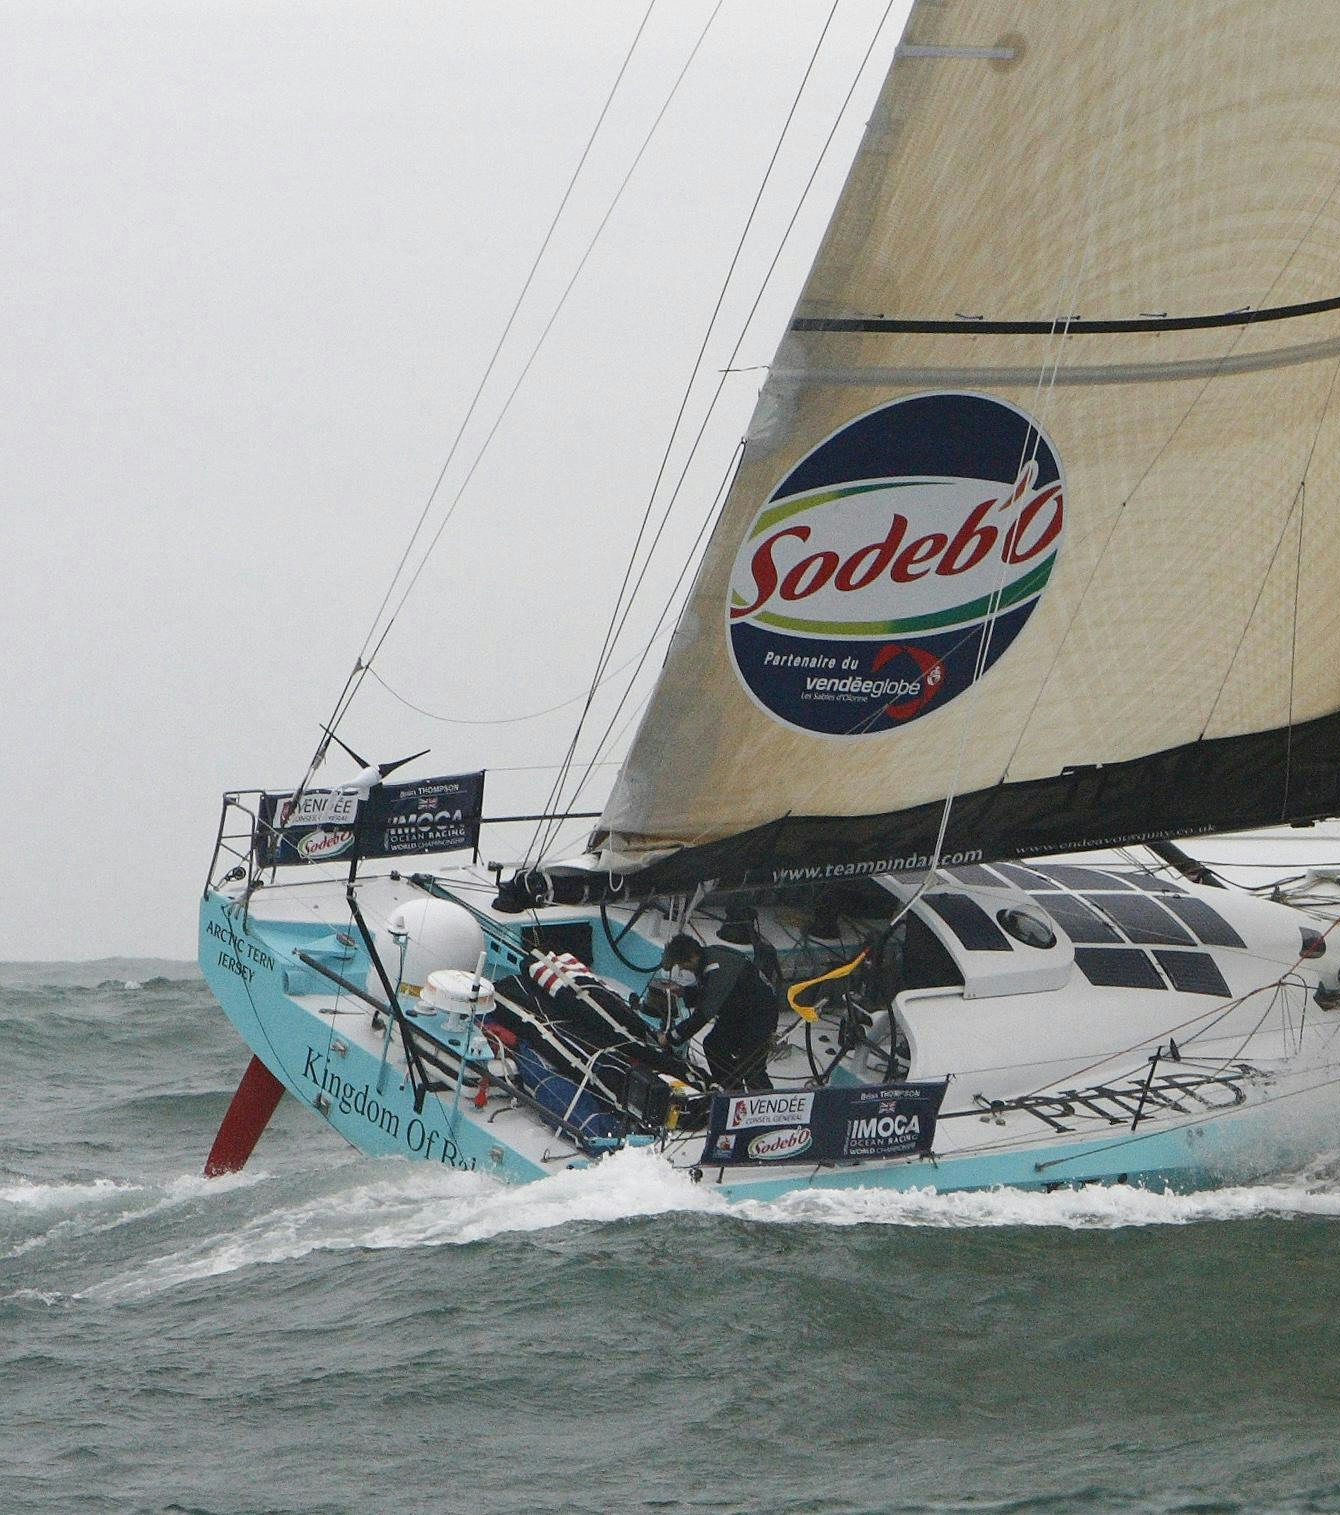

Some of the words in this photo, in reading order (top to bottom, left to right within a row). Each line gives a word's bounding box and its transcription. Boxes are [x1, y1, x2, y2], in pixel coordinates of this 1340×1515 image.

[764, 651, 836, 669] Partenaire
[841, 655, 860, 670] du
[805, 675, 922, 697] vendéeglobe
[418, 783, 460, 795] THOMPSON
[389, 809, 464, 835] IMOCA
[390, 833, 425, 843] OCEAN
[428, 829, 466, 838] RACING
[390, 842, 417, 851] WORLD
[771, 846, 984, 883] www.teampindar.com
[206, 920, 245, 953] ARCTIC
[247, 943, 275, 971] TERN
[217, 951, 255, 983] JERSEY
[301, 1046, 400, 1139] Kingdom
[406, 1118, 440, 1160] Of
[749, 1095, 806, 1115] VENDÉE
[744, 1115, 770, 1125] CONSEIL
[850, 1114, 921, 1139] IMOCA
[849, 1138, 884, 1147] OCEAN
[888, 1134, 918, 1145] RACING
[849, 1147, 875, 1155] WORLD
